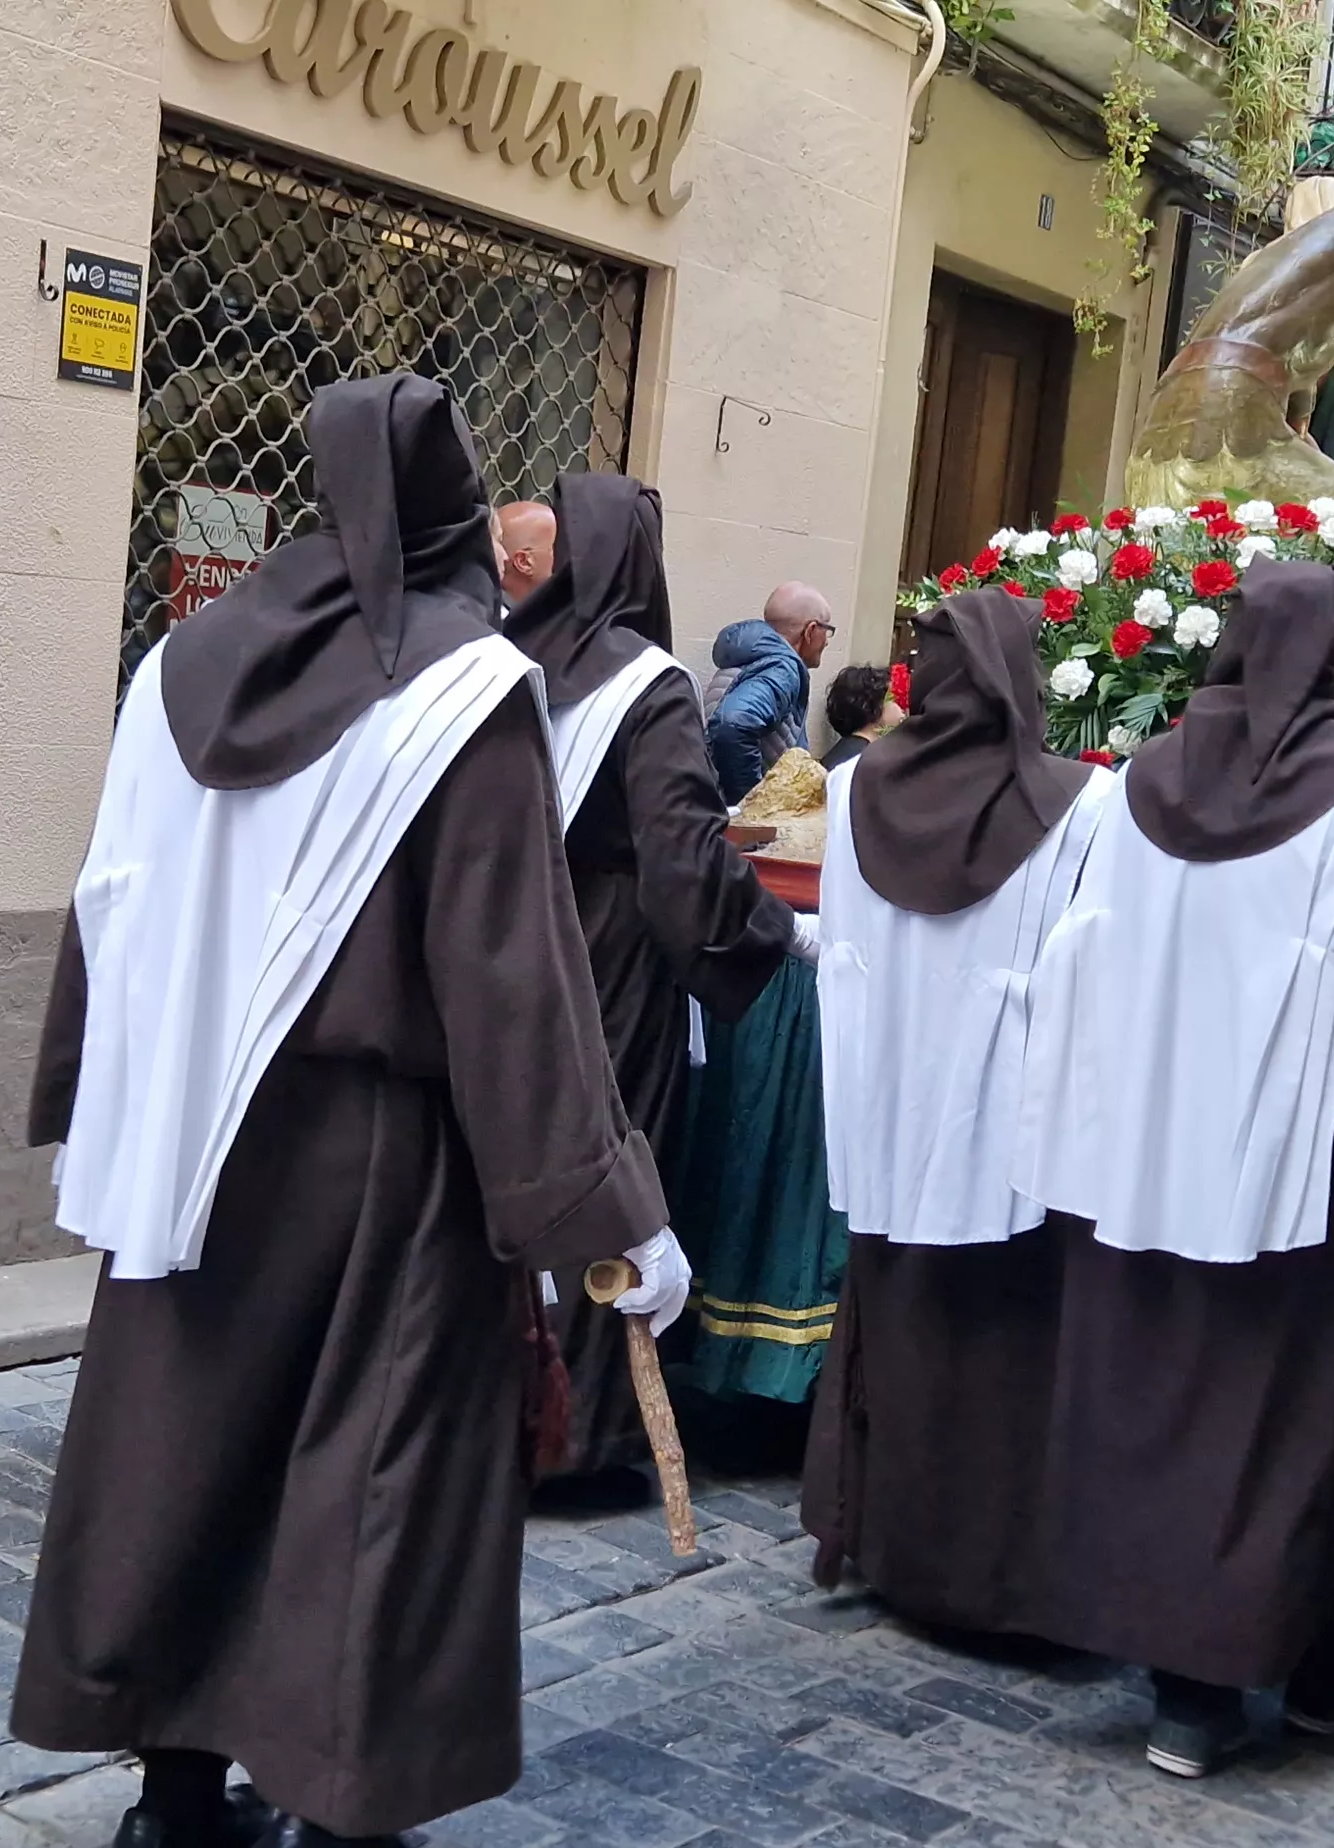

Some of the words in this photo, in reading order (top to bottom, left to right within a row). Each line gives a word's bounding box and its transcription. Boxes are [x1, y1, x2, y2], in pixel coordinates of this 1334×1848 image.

[1040, 196, 1053, 229] 18
[70, 303, 131, 326] CONECTADA
[70, 317, 83, 325] CON
